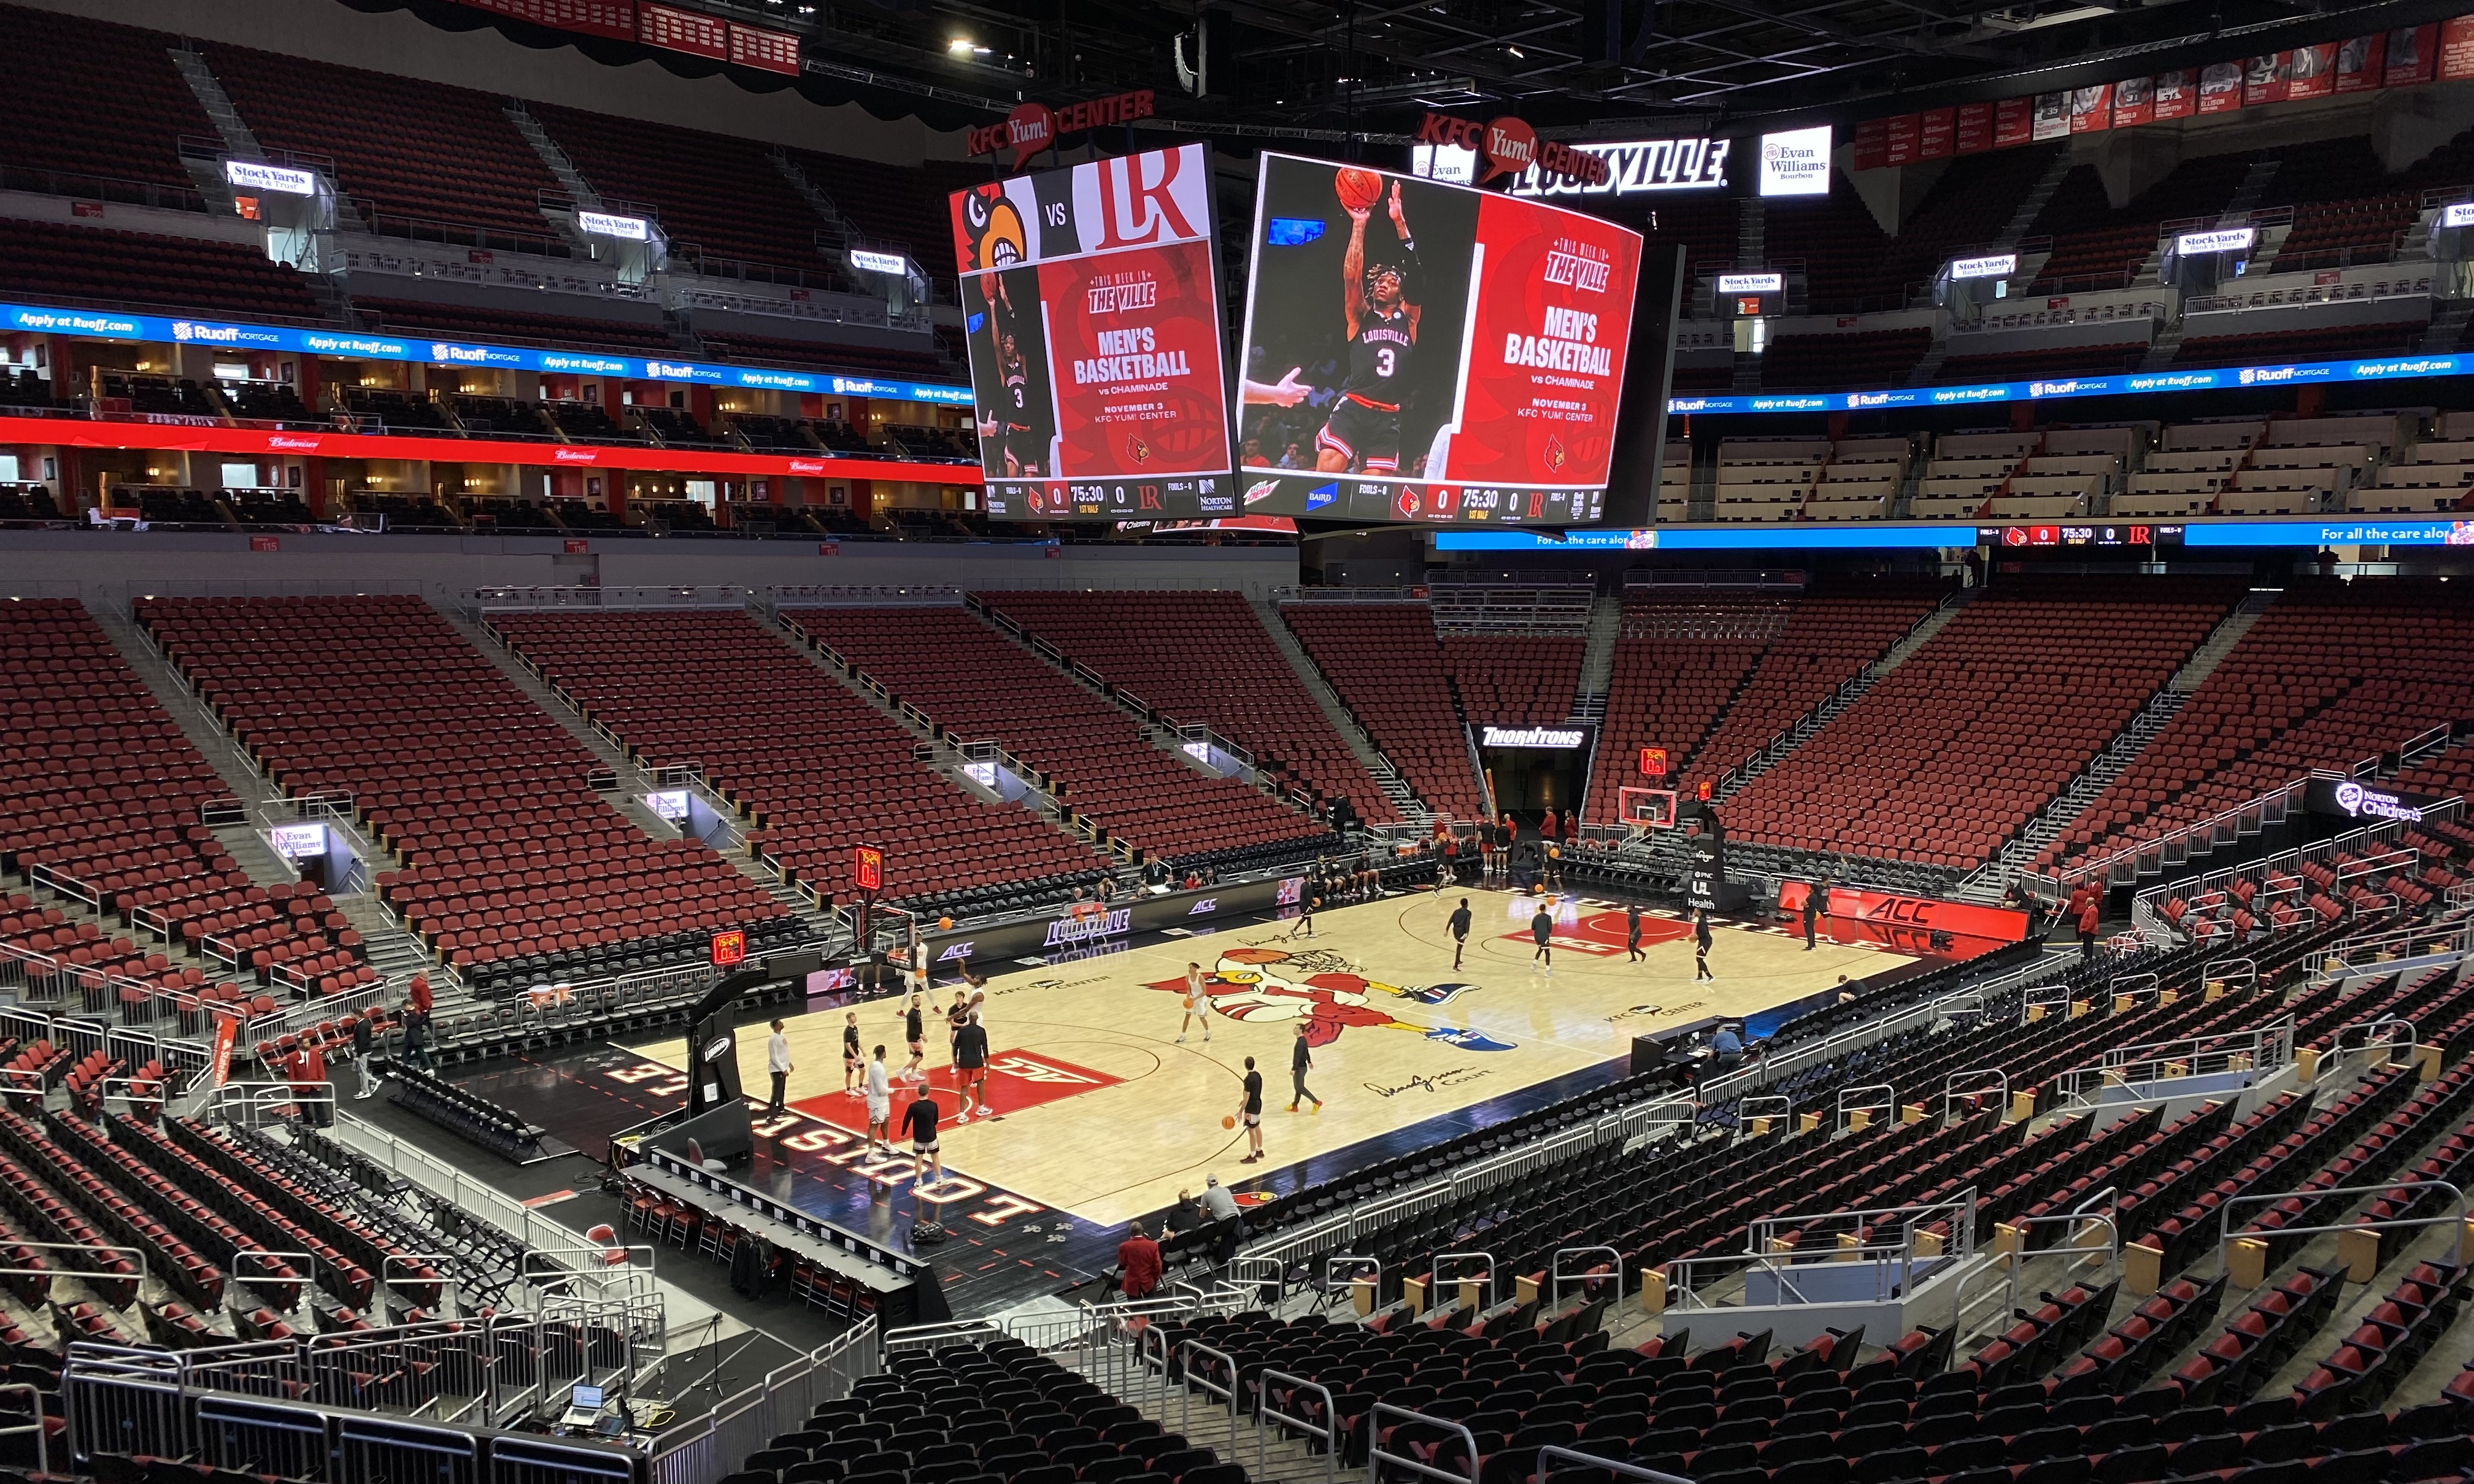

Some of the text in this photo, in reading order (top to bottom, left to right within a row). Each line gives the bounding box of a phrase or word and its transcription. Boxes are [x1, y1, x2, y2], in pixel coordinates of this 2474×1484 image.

[967, 90, 1155, 157] KFC Yum! CENTER
[1419, 112, 1608, 184] KFC Yum! CENTER
[1780, 147, 1814, 158] Evan
[1432, 164, 1461, 175] Evan
[1770, 160, 1826, 172] Williams
[1045, 202, 1066, 226] VS
[1559, 237, 1597, 258] THIS WEEK
[1544, 250, 1610, 293] THE VILLE
[1095, 270, 1146, 288] THIS WEEK IN
[1088, 281, 1157, 315] THE VILLE
[20, 313, 132, 331] Apply Ruoff.com
[1543, 306, 1597, 343] MEN'S
[195, 325, 279, 342] Ruoff MORTGAGE
[1362, 328, 1409, 347] LOUISVILLE
[309, 337, 401, 353] Apply at Ruoff.com
[1097, 328, 1155, 356] MEN'S
[450, 347, 520, 362] Ruoff MORTGAGE
[1504, 333, 1611, 376] BASKETBALL
[545, 357, 569, 368] Apply
[582, 360, 622, 371] Ruoff.com
[1074, 351, 1190, 384] BASKETBALL
[1376, 347, 1395, 377] 3
[2357, 364, 2386, 375] Apply
[2400, 361, 2451, 372] Ruoff.com
[662, 365, 722, 379] Ruoff MORTGAGE
[2257, 368, 2294, 380] Ruoff
[742, 374, 763, 384] Apply
[774, 377, 809, 386] Ruoff.com
[1545, 375, 1595, 390] CHAMINADE
[2131, 379, 2155, 389] Apply
[2168, 376, 2211, 386] Ruoff.com
[846, 382, 872, 393] Ruoff
[1111, 382, 1168, 394] CHAMINADE
[2045, 382, 2076, 393] Ruoff
[915, 389, 933, 398] Apply
[942, 391, 973, 400] Ruoff.com
[1014, 388, 1023, 409] 3
[1860, 394, 1889, 405] Ruoff
[1935, 392, 1956, 401] Apply
[1967, 390, 2004, 398] Ruoff.com
[1104, 402, 1163, 413] NOVEMBER 3
[1532, 398, 1587, 411] NOVEMBER 3
[1676, 400, 1705, 410] Ruoff
[1786, 399, 1822, 408] Ruoff.com
[1095, 411, 1176, 423] KFC YUM! CENTER
[1517, 407, 1593, 422] KFC YUM! CENTER
[269, 436, 319, 448] Budweiser
[555, 449, 595, 461] Budweiser
[789, 462, 823, 472] Budweiser
[1168, 482, 1183, 491] FOULS
[1359, 484, 1378, 494] FOULS
[1053, 488, 1061, 505] 0
[1071, 486, 1104, 503] 75:30
[1116, 487, 1124, 504] 0
[1200, 496, 1232, 506] NORTON
[1309, 493, 1331, 502] BAIRD
[1438, 490, 1447, 509] 0
[1463, 489, 1498, 508] 75:30
[1509, 492, 1518, 511] 0
[1079, 504, 1099, 513] 1ST HALF
[1477, 510, 1488, 520] HALF
[1537, 535, 1552, 545] For
[1568, 534, 1608, 545] the care
[2040, 529, 2048, 540] 0
[2062, 528, 2092, 539] 75:30
[2106, 528, 2114, 540] 0
[2322, 528, 2416, 540] For all the care
[262, 542, 277, 552] 115
[573, 545, 586, 553] 116
[1482, 726, 1582, 747] THORNTONS
[2364, 793, 2398, 804] NORTON
[286, 832, 312, 840] Evan
[1695, 850, 1714, 863] Kroger
[1189, 898, 1217, 913] ACC
[1688, 898, 1714, 910] Health
[1868, 898, 1937, 925] ACC
[938, 942, 974, 959] ACC
[993, 986, 1029, 996] KFC
[1055, 975, 1111, 990] CENTER
[1603, 1012, 1635, 1023] KFC
[1660, 1001, 1707, 1017] CENTER
[704, 1040, 727, 1062] LIBMAN
[1441, 1069, 1495, 1087] Court
